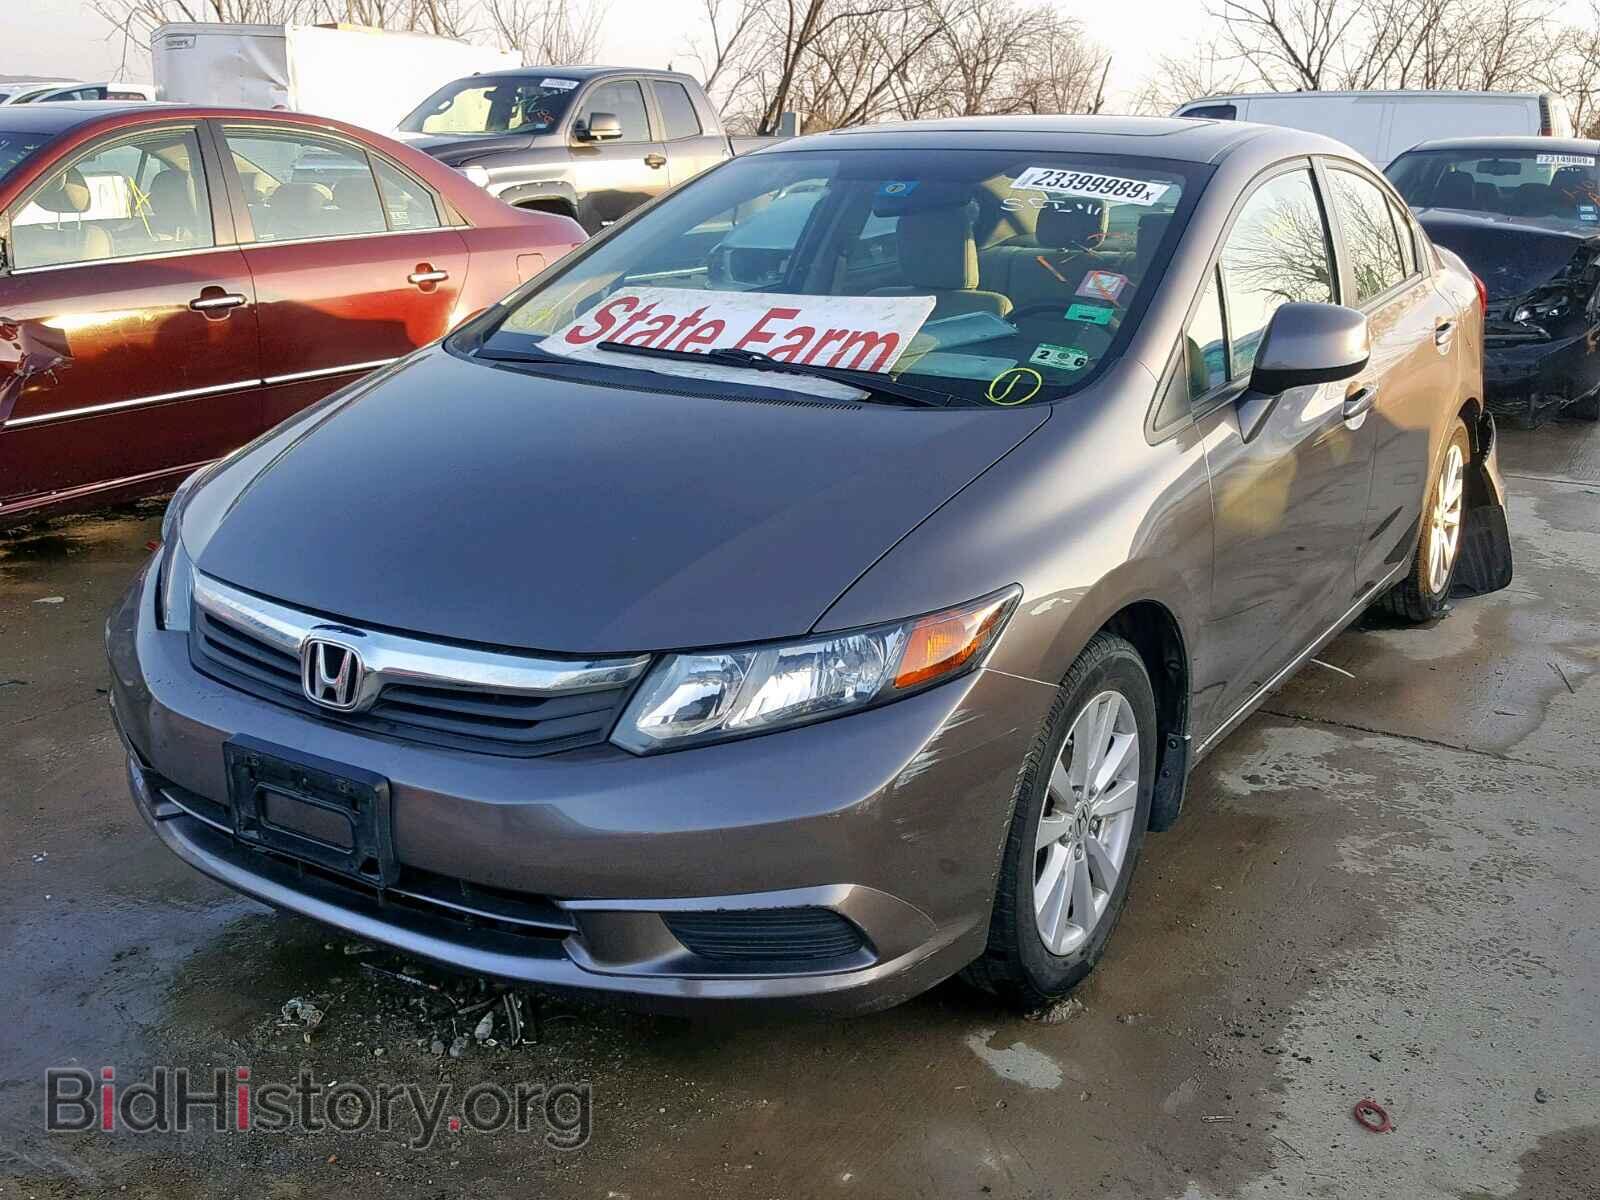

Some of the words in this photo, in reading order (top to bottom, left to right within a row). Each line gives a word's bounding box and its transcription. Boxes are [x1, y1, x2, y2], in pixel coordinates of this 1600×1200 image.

[1032, 170, 1153, 201] 23399989x
[565, 296, 726, 353] State
[733, 306, 900, 374] Farm
[1036, 350, 1051, 360] 2
[1073, 357, 1086, 367] 6
